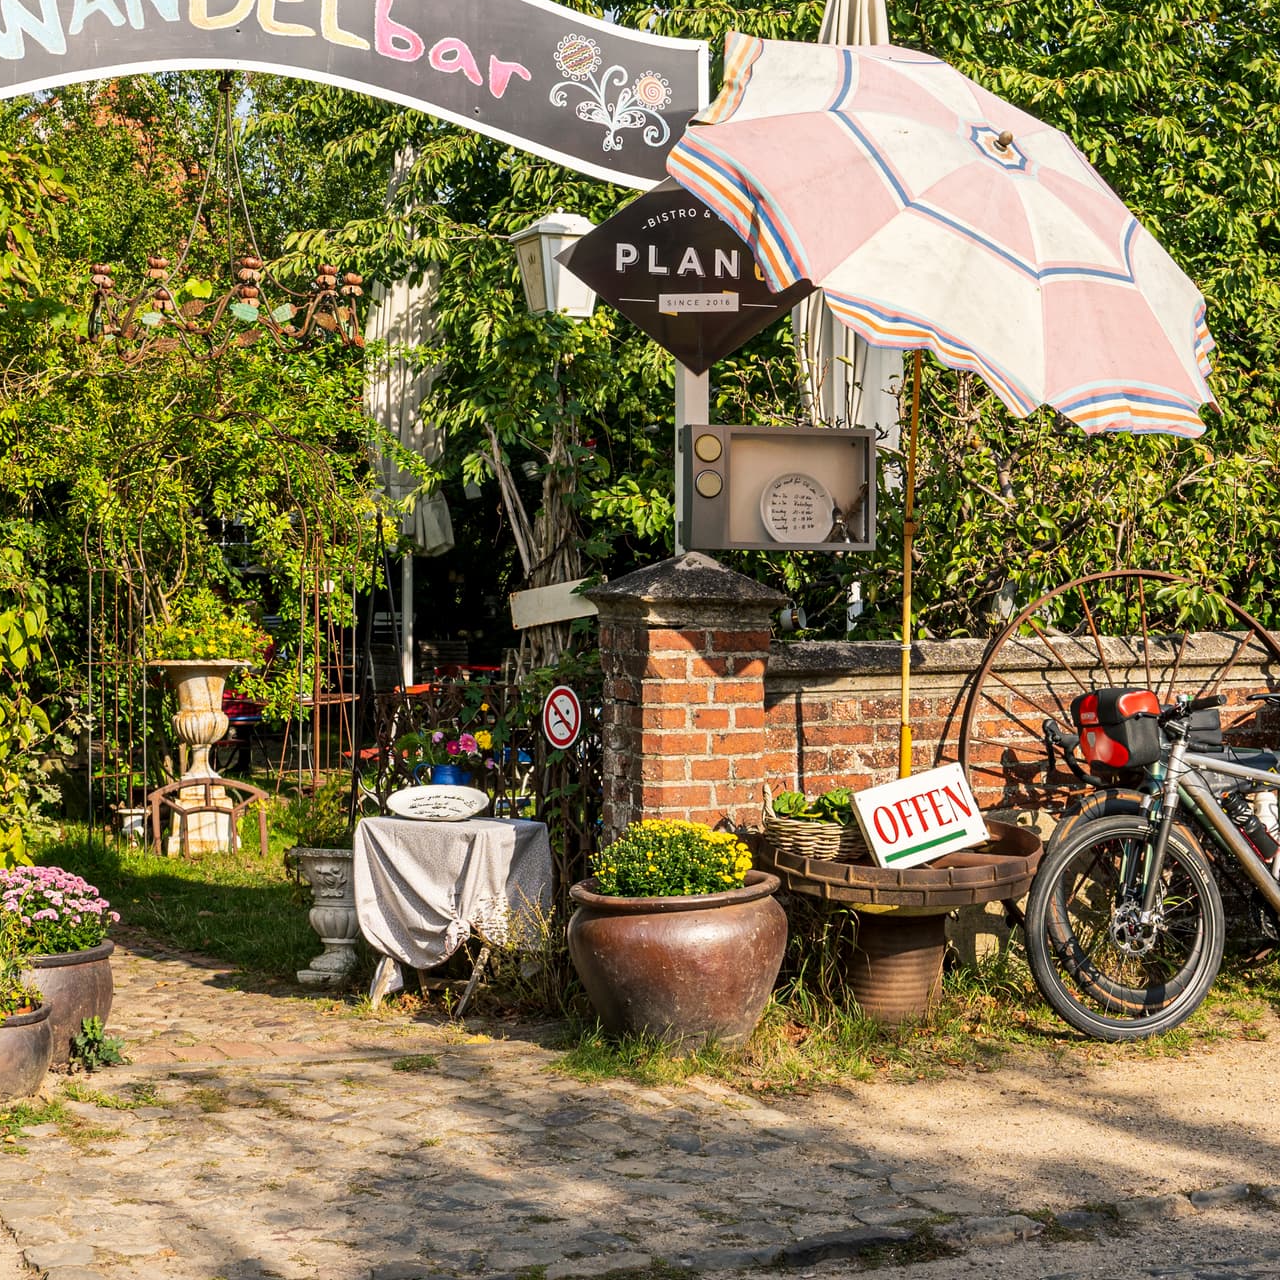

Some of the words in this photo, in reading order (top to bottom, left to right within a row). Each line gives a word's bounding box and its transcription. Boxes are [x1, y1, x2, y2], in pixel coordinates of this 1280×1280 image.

[703, 209, 711, 219] &
[666, 298, 700, 307] SINCE
[705, 298, 731, 307] 2016
[873, 781, 973, 845] OFFEN
